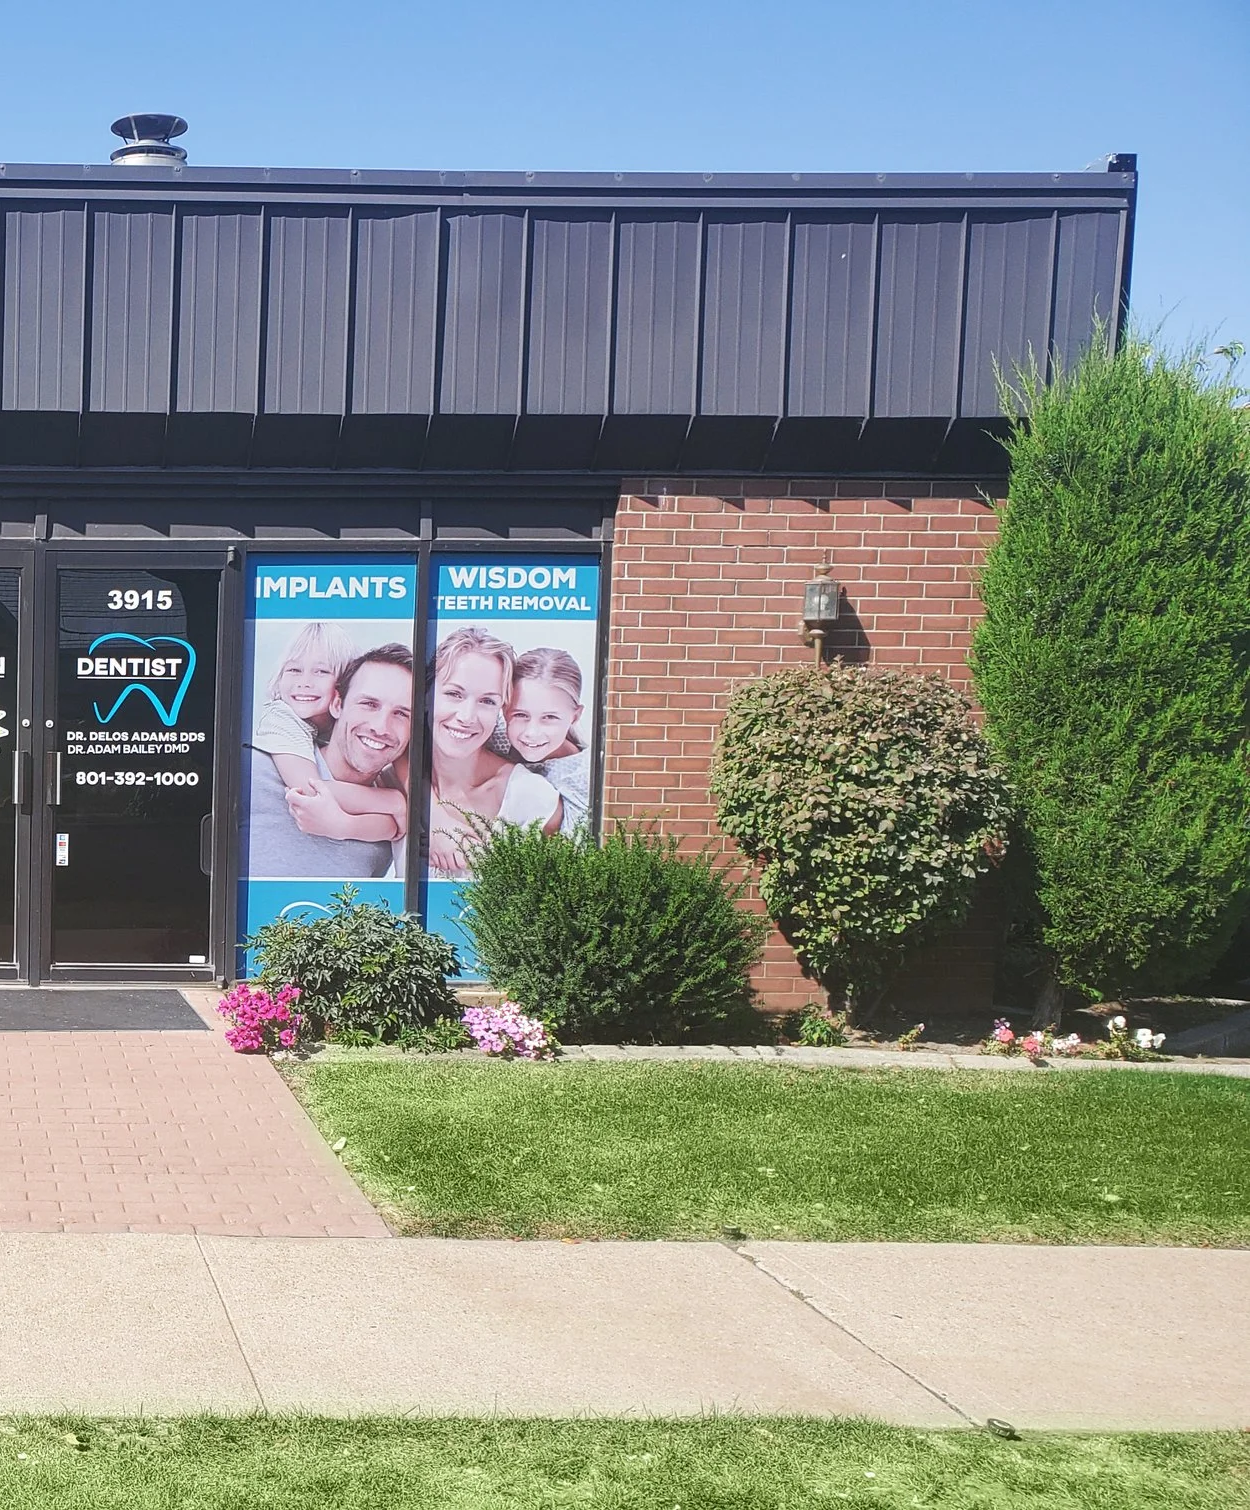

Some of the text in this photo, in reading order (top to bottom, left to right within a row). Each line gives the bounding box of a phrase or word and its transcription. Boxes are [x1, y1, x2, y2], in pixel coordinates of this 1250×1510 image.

[447, 566, 577, 590] WISDOM
[254, 575, 407, 600] IMPLANTS
[107, 589, 173, 610] 3915
[432, 595, 591, 611] TEETH REMOVAL
[77, 657, 182, 676] DENTIST
[66, 731, 206, 742] DR. DELOS ADAMS DDS
[67, 743, 190, 755] DR. ADAM BAILEY DMD
[75, 771, 199, 786] 801-392-1000
